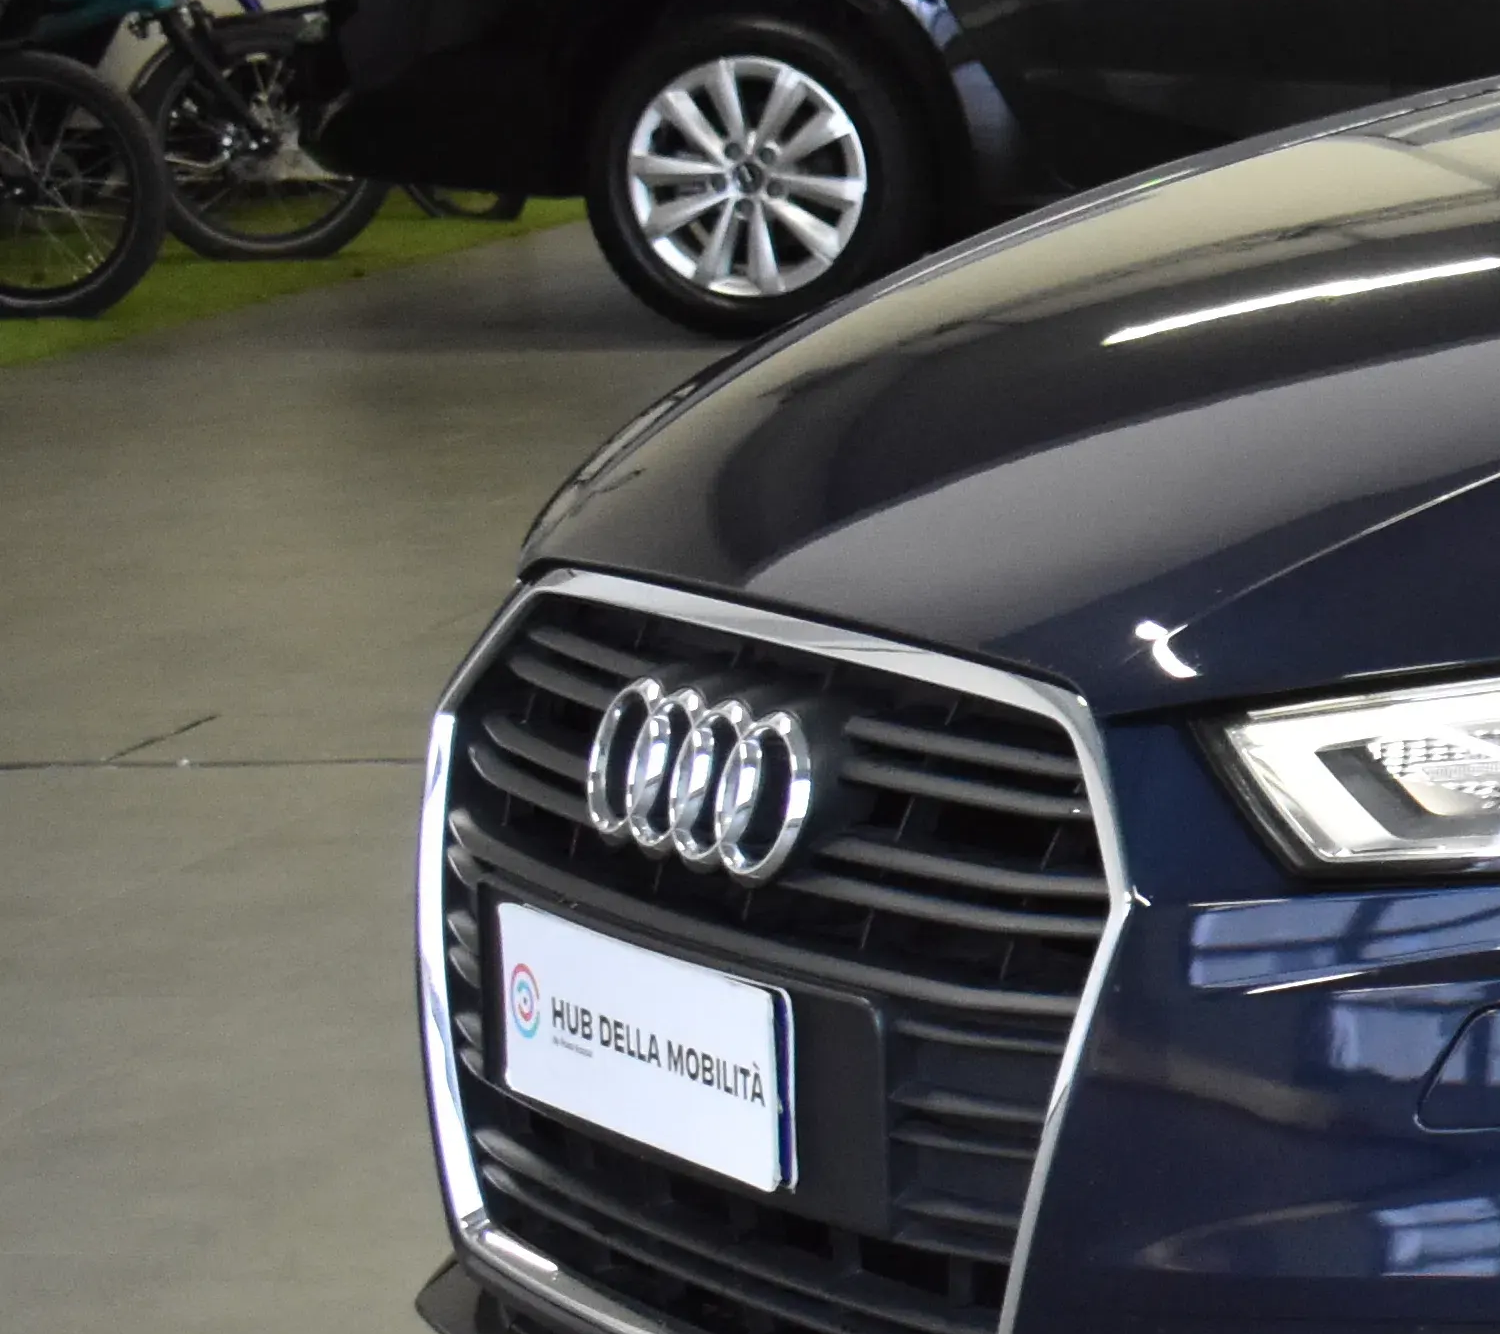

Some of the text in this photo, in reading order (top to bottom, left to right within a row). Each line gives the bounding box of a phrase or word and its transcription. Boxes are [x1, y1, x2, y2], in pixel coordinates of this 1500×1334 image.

[551, 996, 593, 1041] HUB
[599, 1013, 662, 1068] DELLA
[667, 1039, 766, 1107] MOBILITÀ
